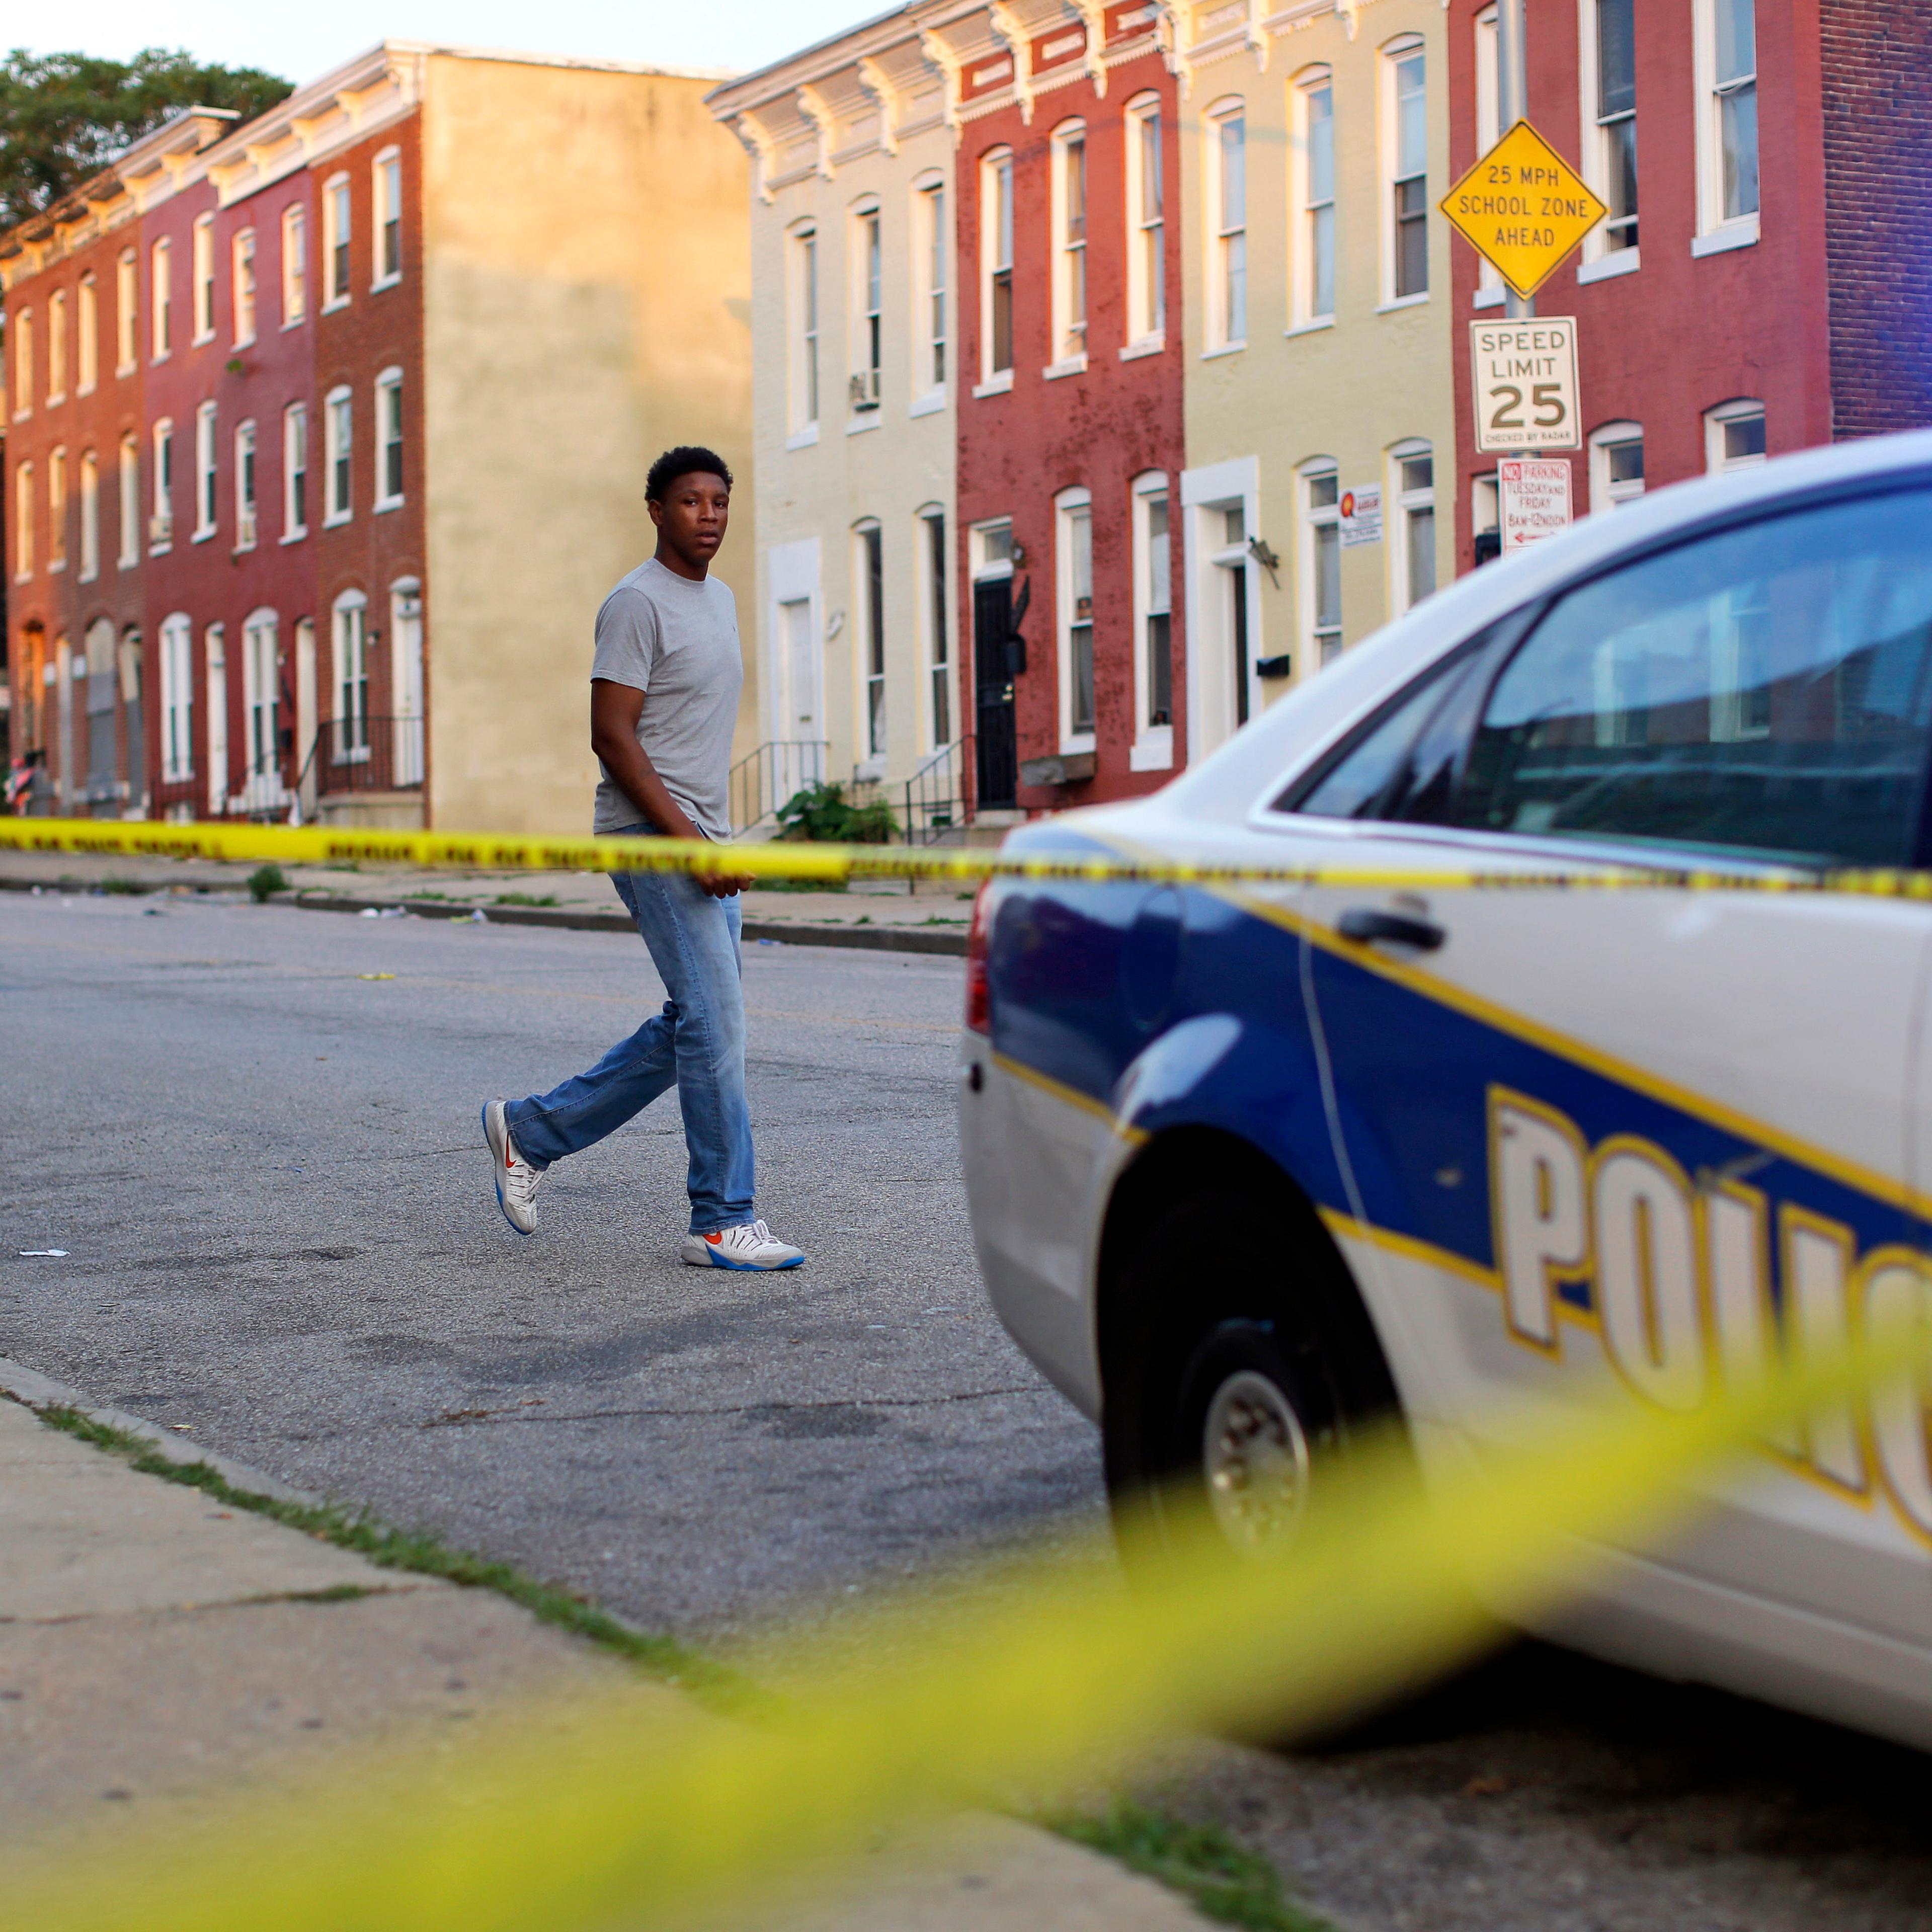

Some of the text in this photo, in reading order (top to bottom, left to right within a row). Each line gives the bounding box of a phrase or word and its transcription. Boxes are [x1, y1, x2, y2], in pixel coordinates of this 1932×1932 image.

[1488, 166, 1559, 186] 25 MPH
[1460, 195, 1588, 217] SCHOOL ZONE
[1495, 227, 1555, 247] AHEAD
[1482, 332, 1564, 352] SPEED
[1492, 357, 1556, 377] LIMIT
[1490, 383, 1566, 428] 25
[1527, 432, 1539, 442] BY
[1542, 431, 1570, 440] RADAR
[1524, 465, 1565, 479] PARKING
[1519, 496, 1552, 508] FRIDAY
